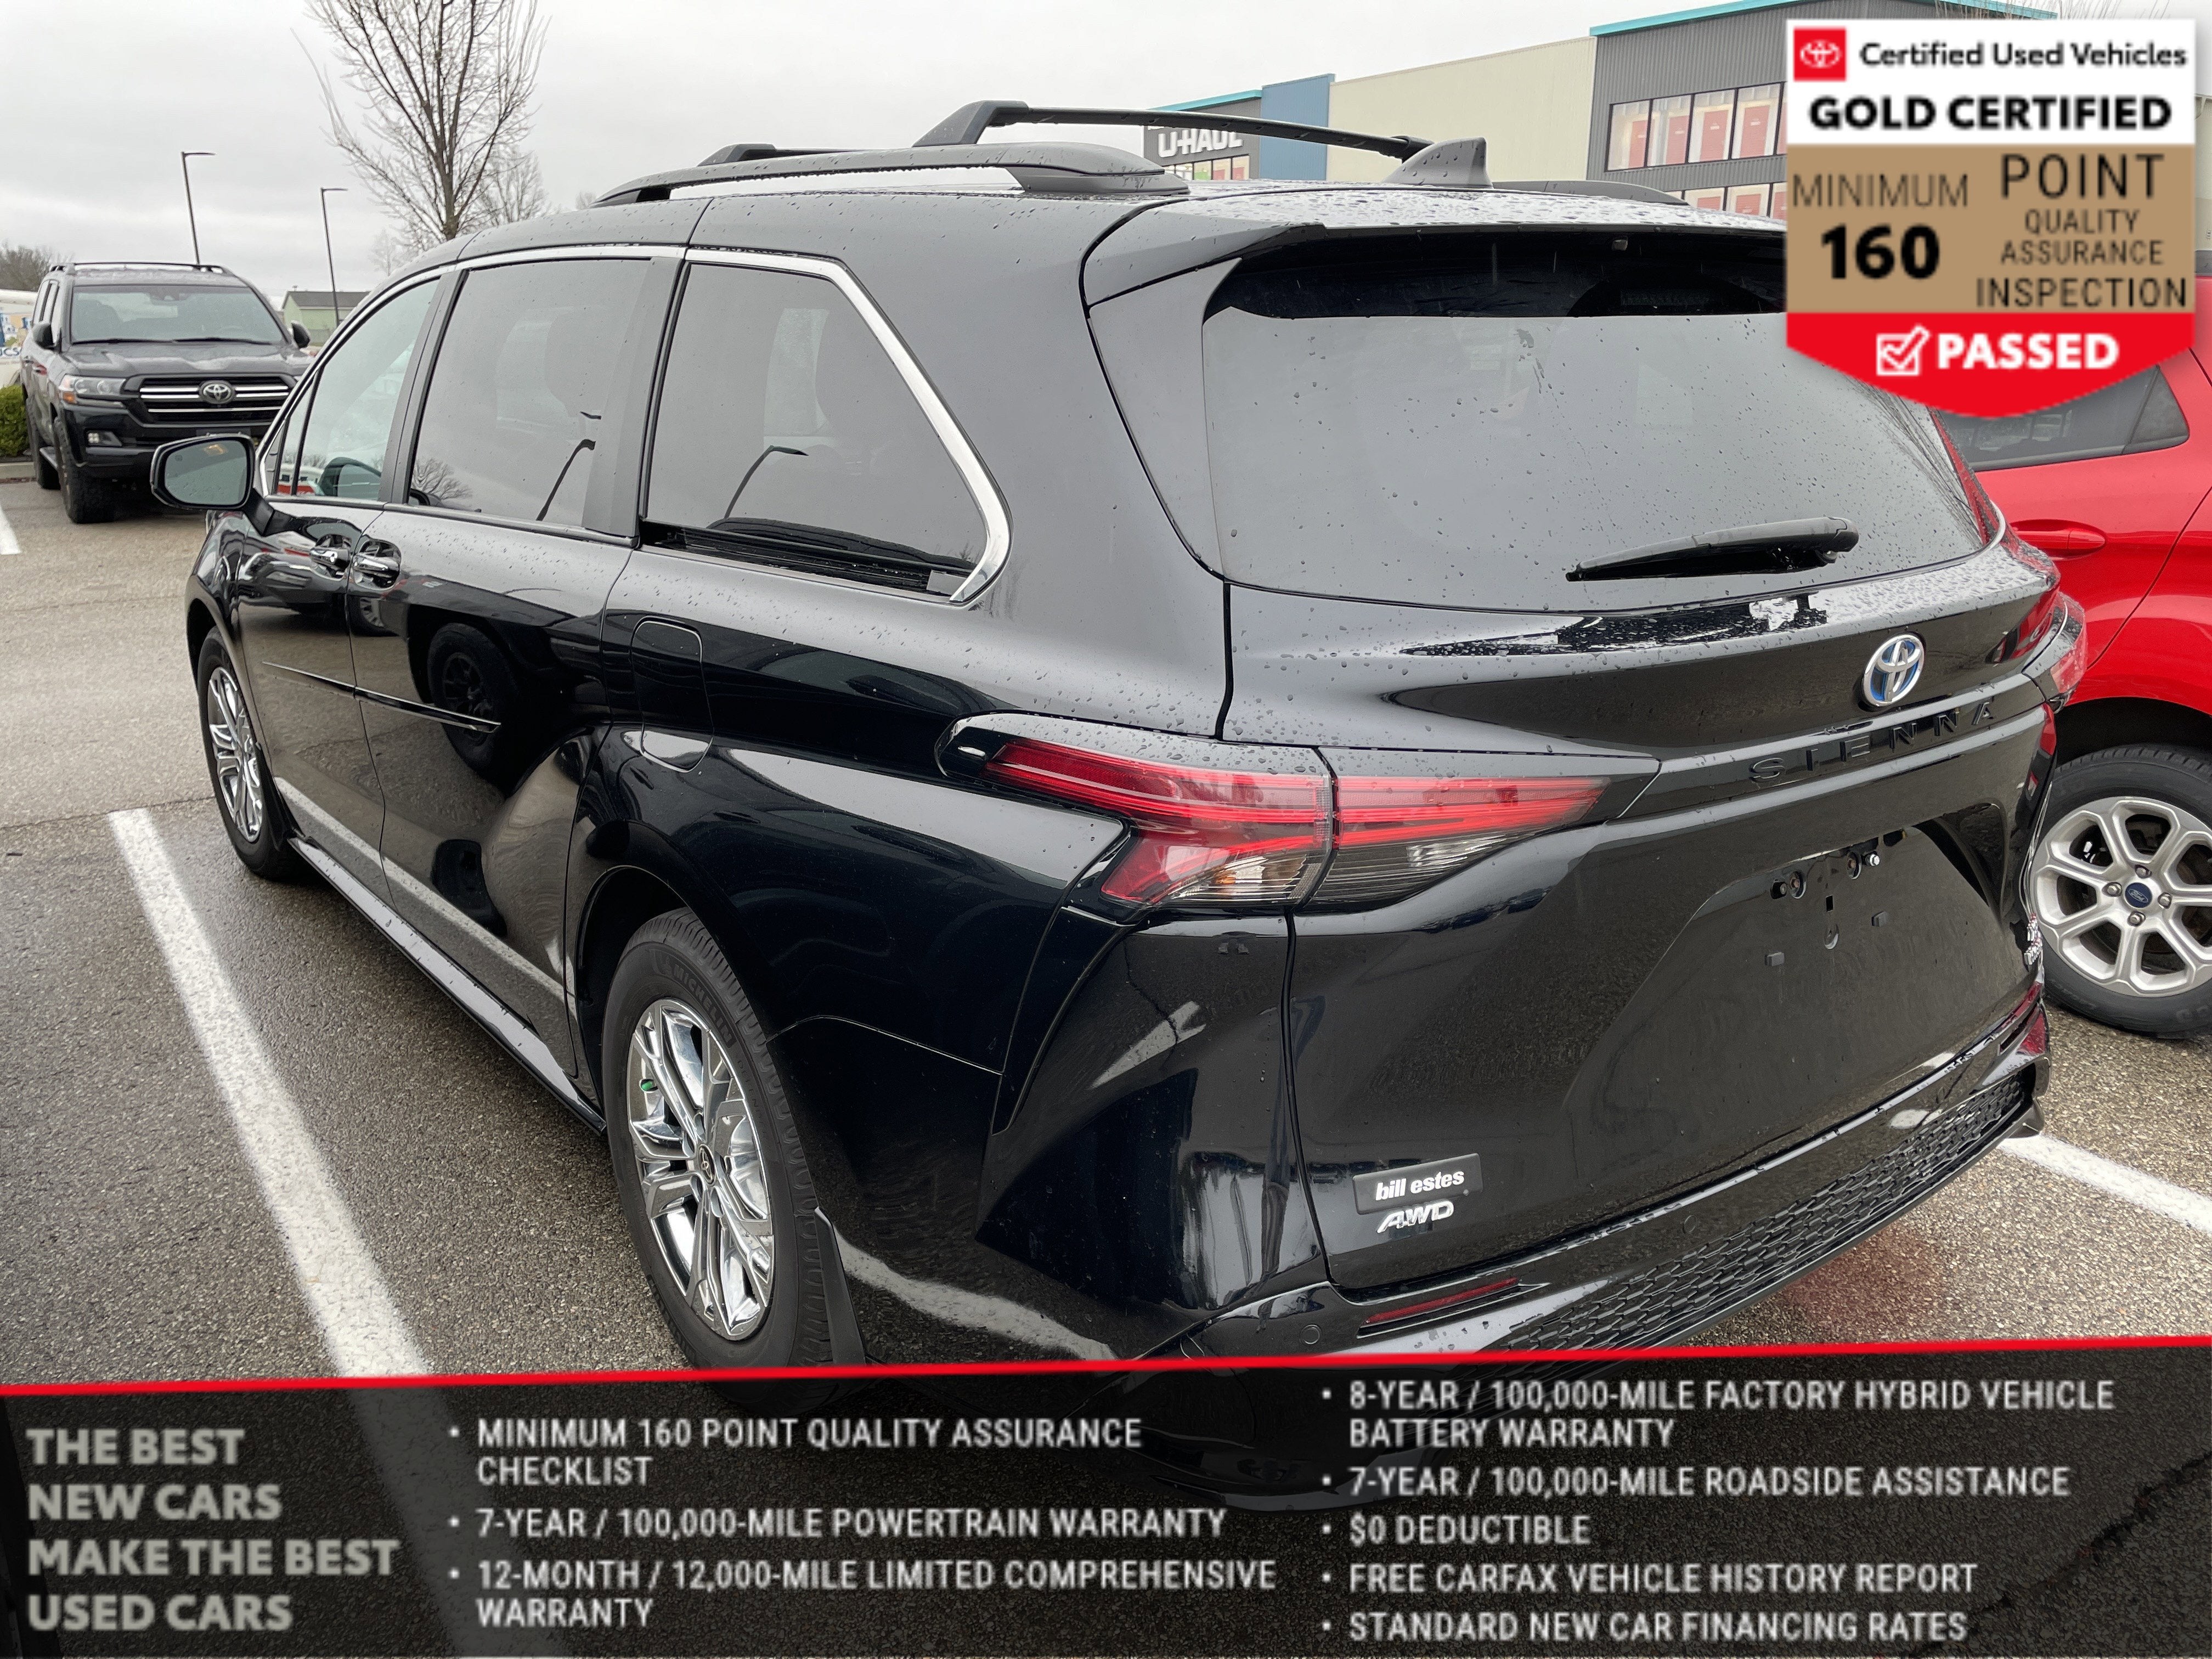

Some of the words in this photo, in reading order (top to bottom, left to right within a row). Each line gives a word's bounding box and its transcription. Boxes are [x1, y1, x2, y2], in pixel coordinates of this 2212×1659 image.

[1158, 128, 1243, 158] U-HAUL
[1750, 701, 1996, 785] SIENNA
[673, 964, 733, 1045] MICHELIN
[1375, 1177, 1407, 1201] bill
[1410, 1171, 1465, 1194] estes
[1376, 1199, 1455, 1234] AWD
